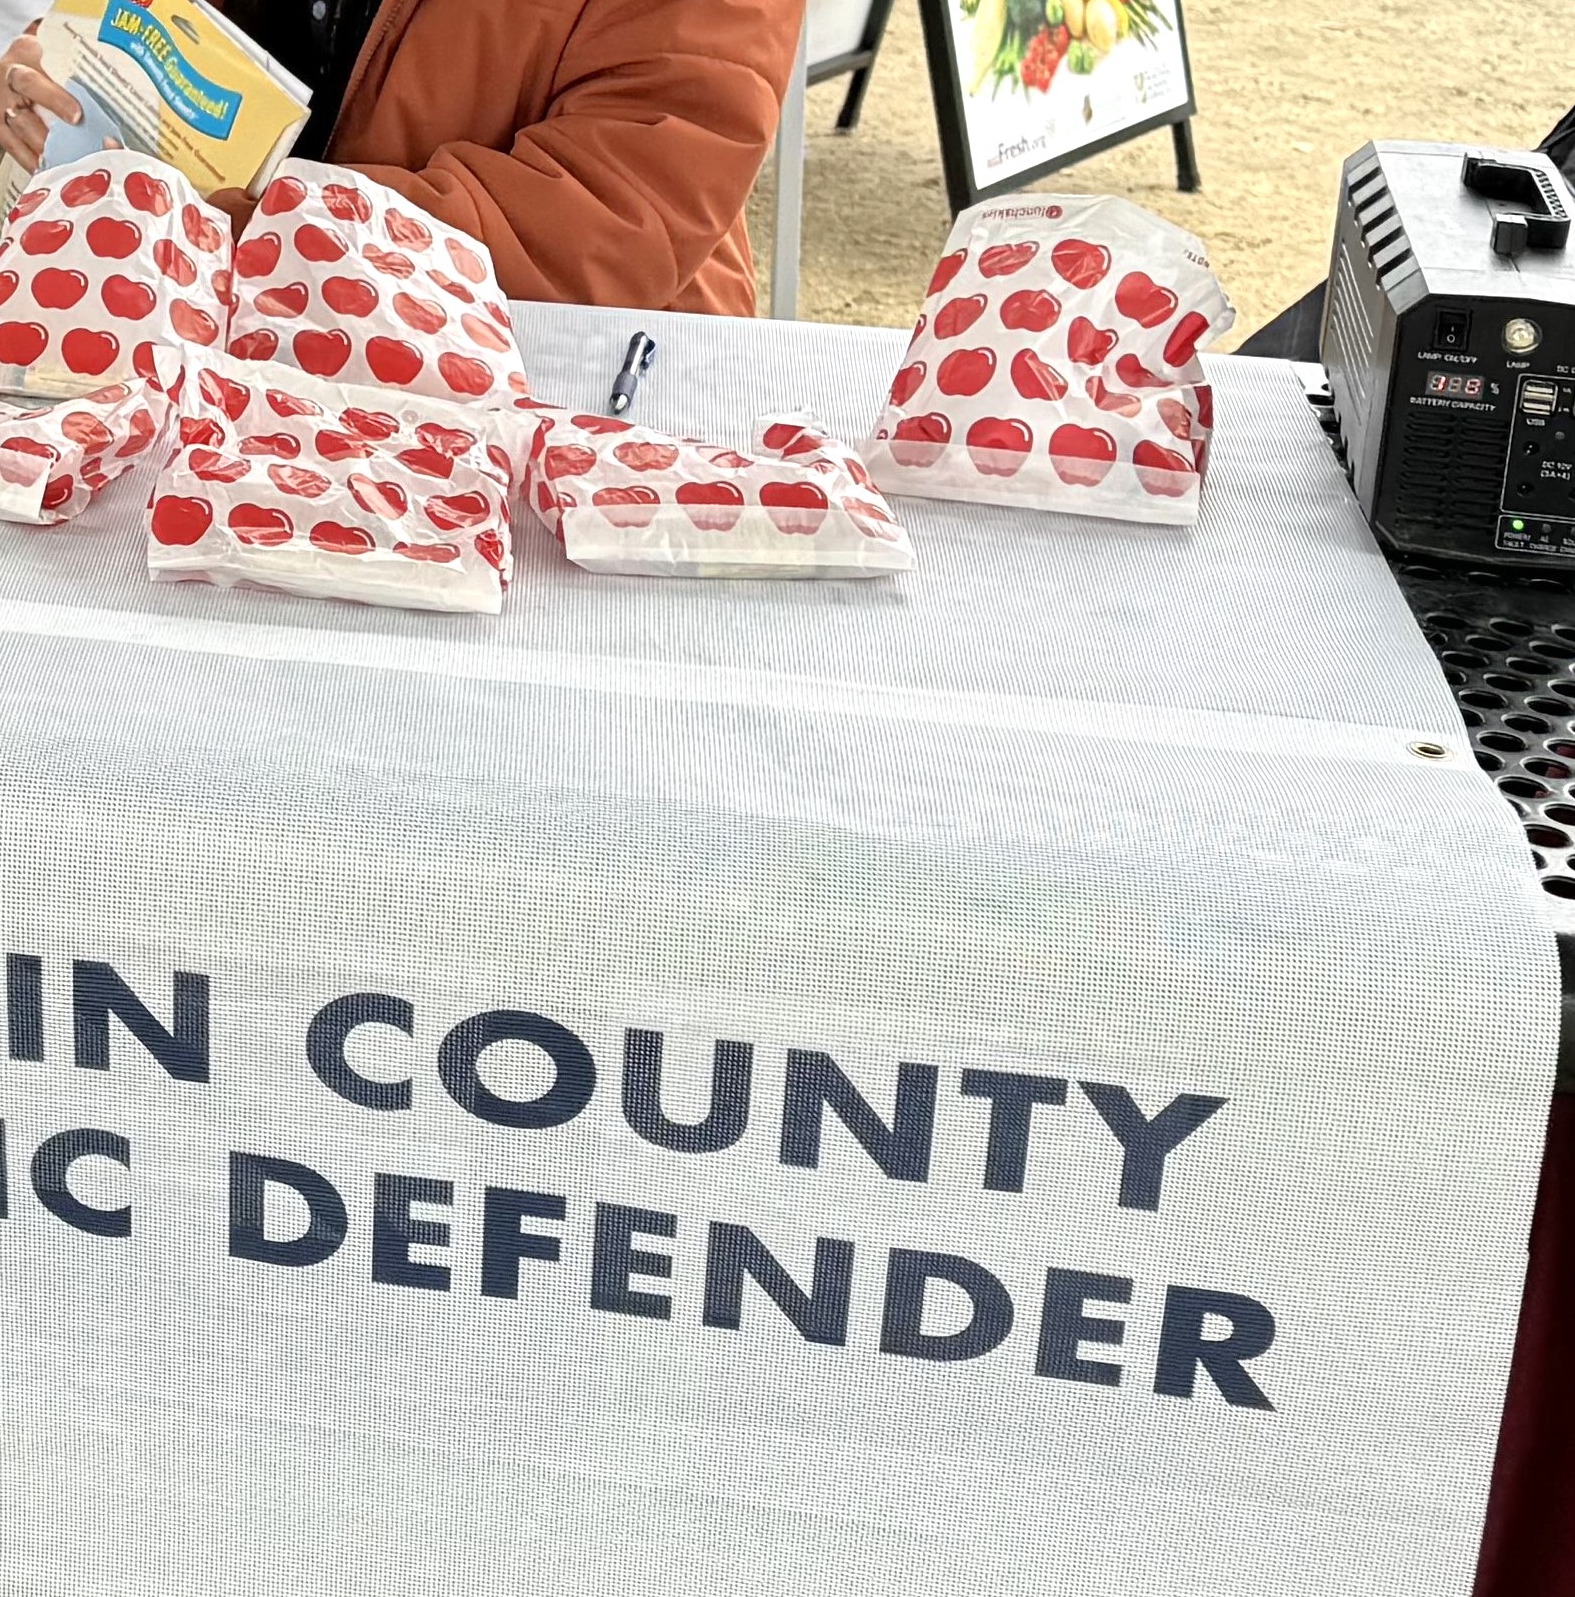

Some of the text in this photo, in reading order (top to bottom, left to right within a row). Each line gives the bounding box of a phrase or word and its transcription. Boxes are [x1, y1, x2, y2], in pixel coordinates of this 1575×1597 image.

[1409, 396, 1498, 412] BATTERY CAPACITY
[302, 989, 1231, 1214] COUNTY
[224, 1150, 1280, 1413] DEFENDER
